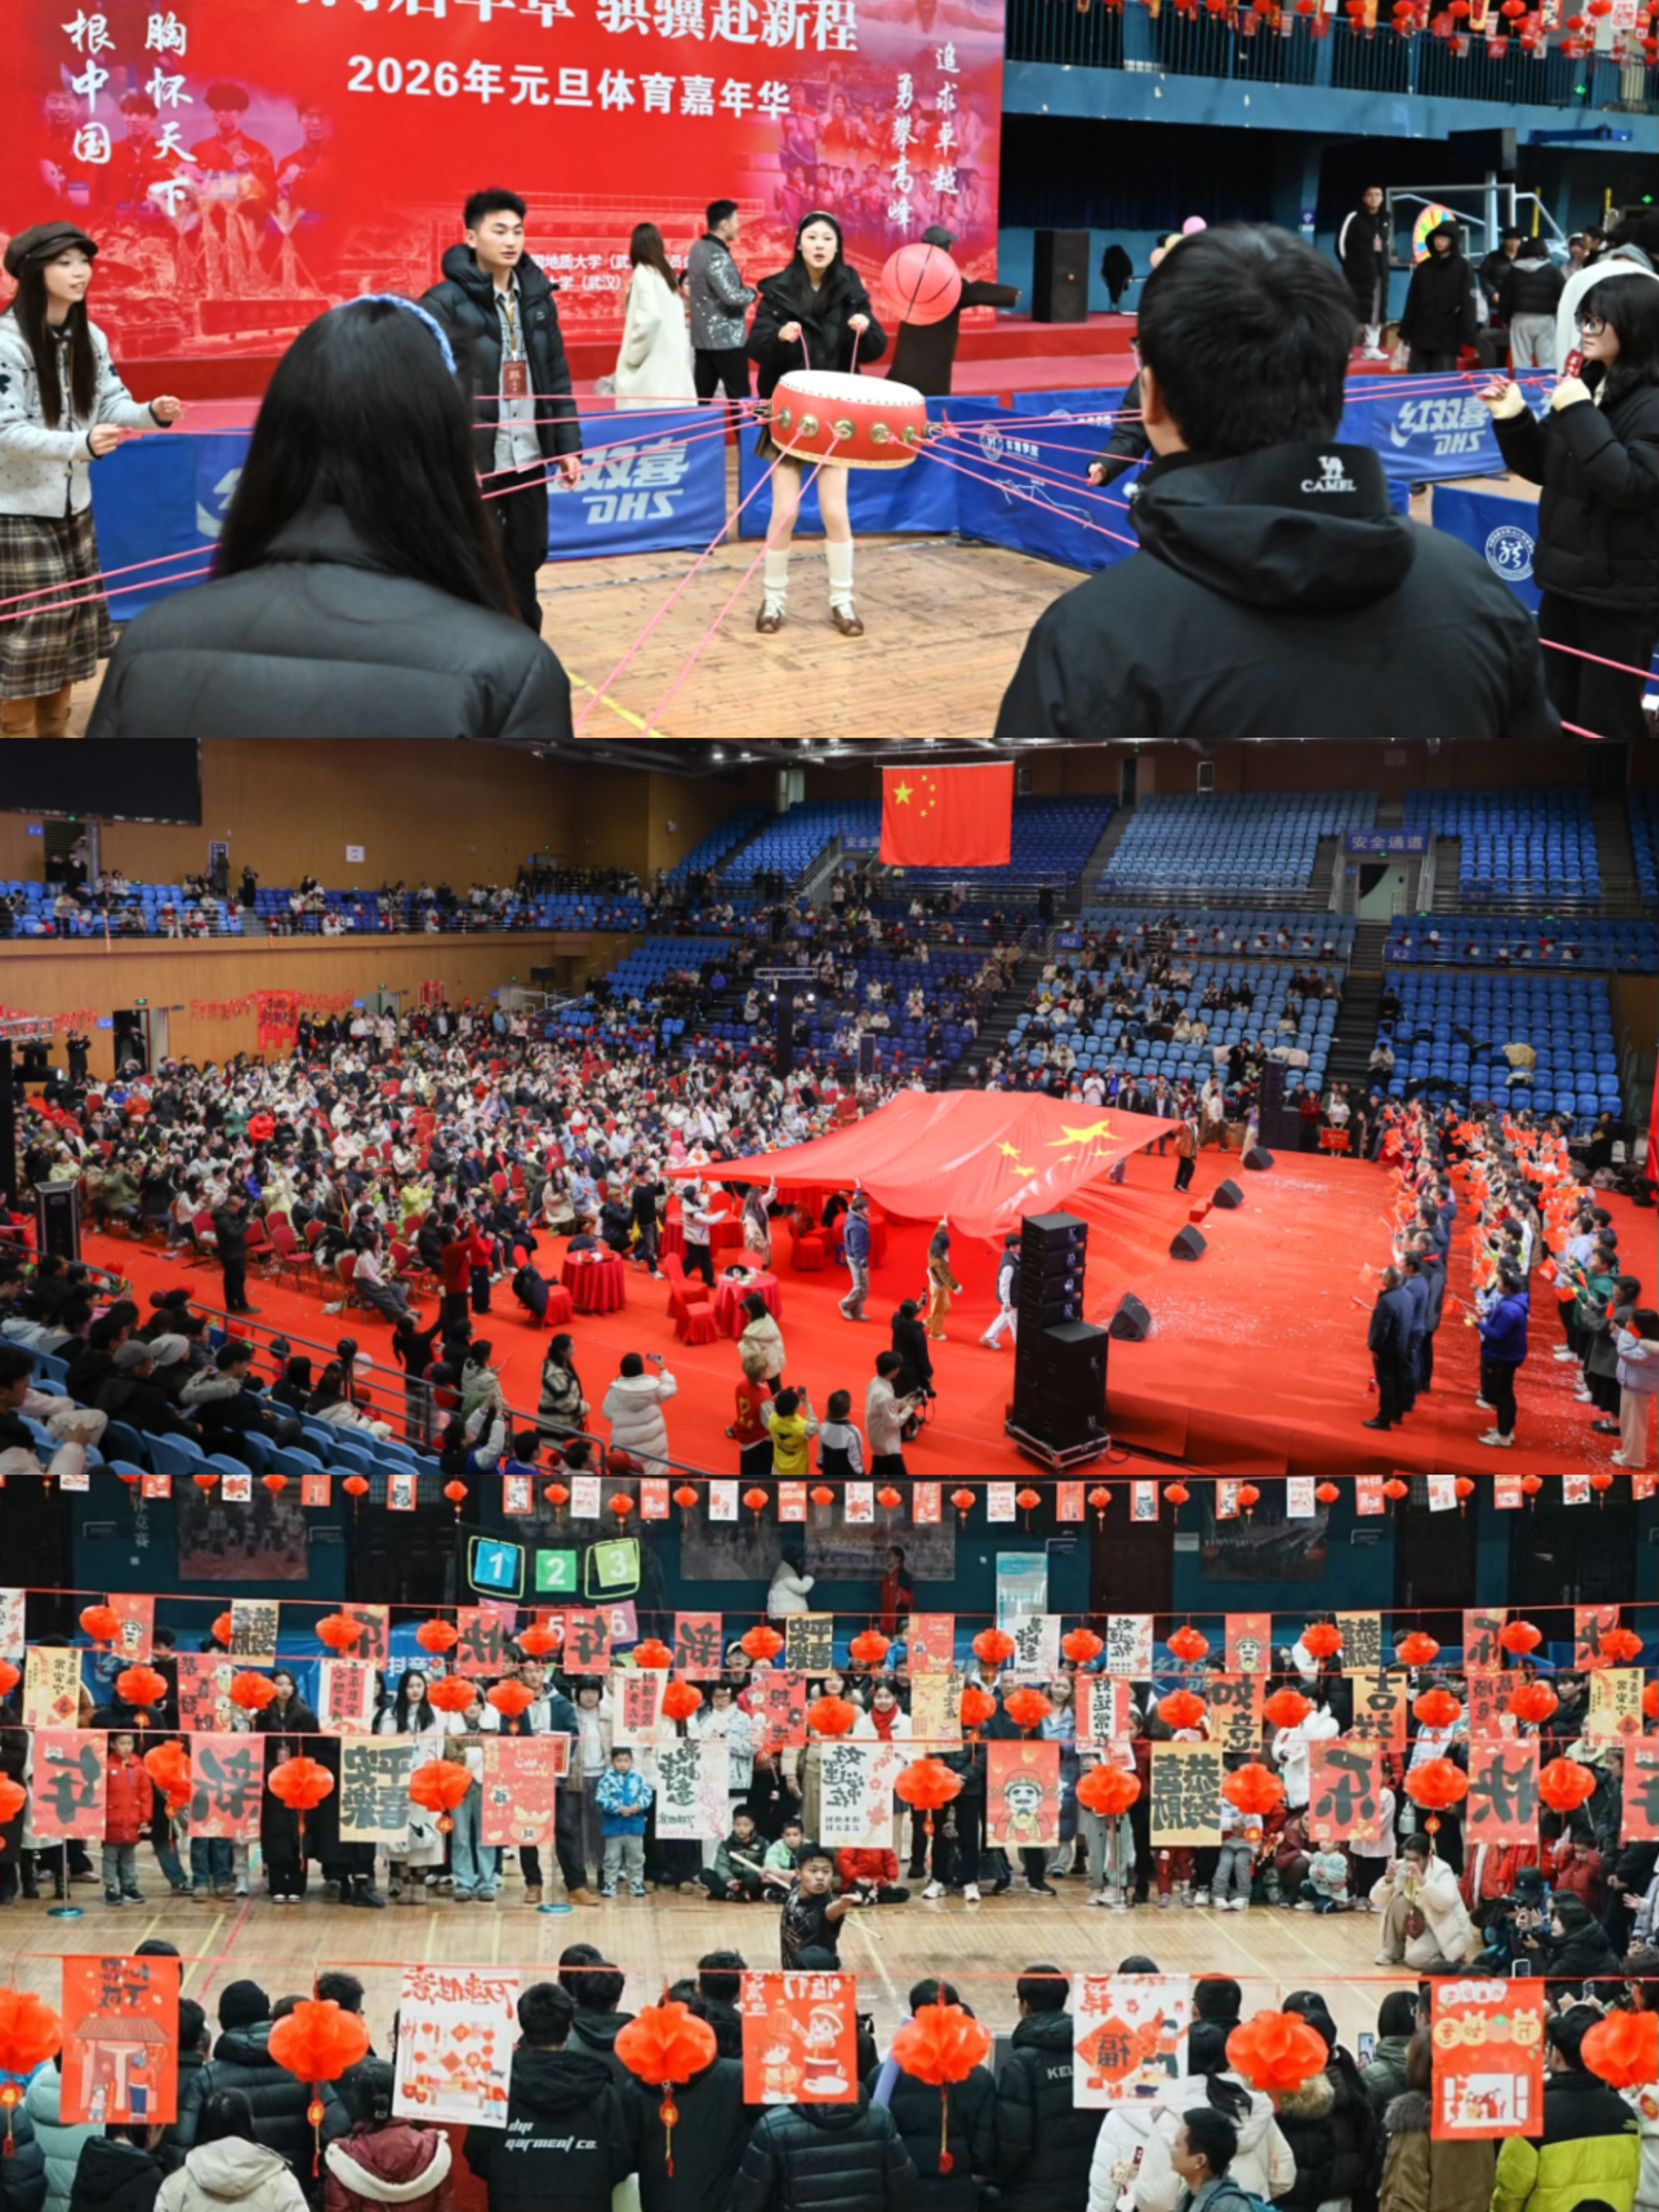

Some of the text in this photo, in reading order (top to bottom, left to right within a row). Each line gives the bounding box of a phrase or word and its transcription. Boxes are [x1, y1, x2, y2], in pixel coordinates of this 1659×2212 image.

[61, 9, 116, 164] 根中国
[347, 55, 791, 119] 2026年元旦体育嘉年华
[145, 11, 198, 218] 胸怀天下
[930, 41, 960, 195] 追求卓越
[888, 73, 919, 235] 勇攀高峰
[1432, 430, 1479, 455] DHS
[1300, 479, 1357, 492] CAMEL
[582, 489, 684, 524] DHS
[1352, 835, 1423, 849] 安全通道
[1062, 939, 1076, 948] H2
[1392, 949, 1410, 960] K2
[490, 1551, 627, 1585] 1 2 3
[548, 1609, 627, 1643] 5 6
